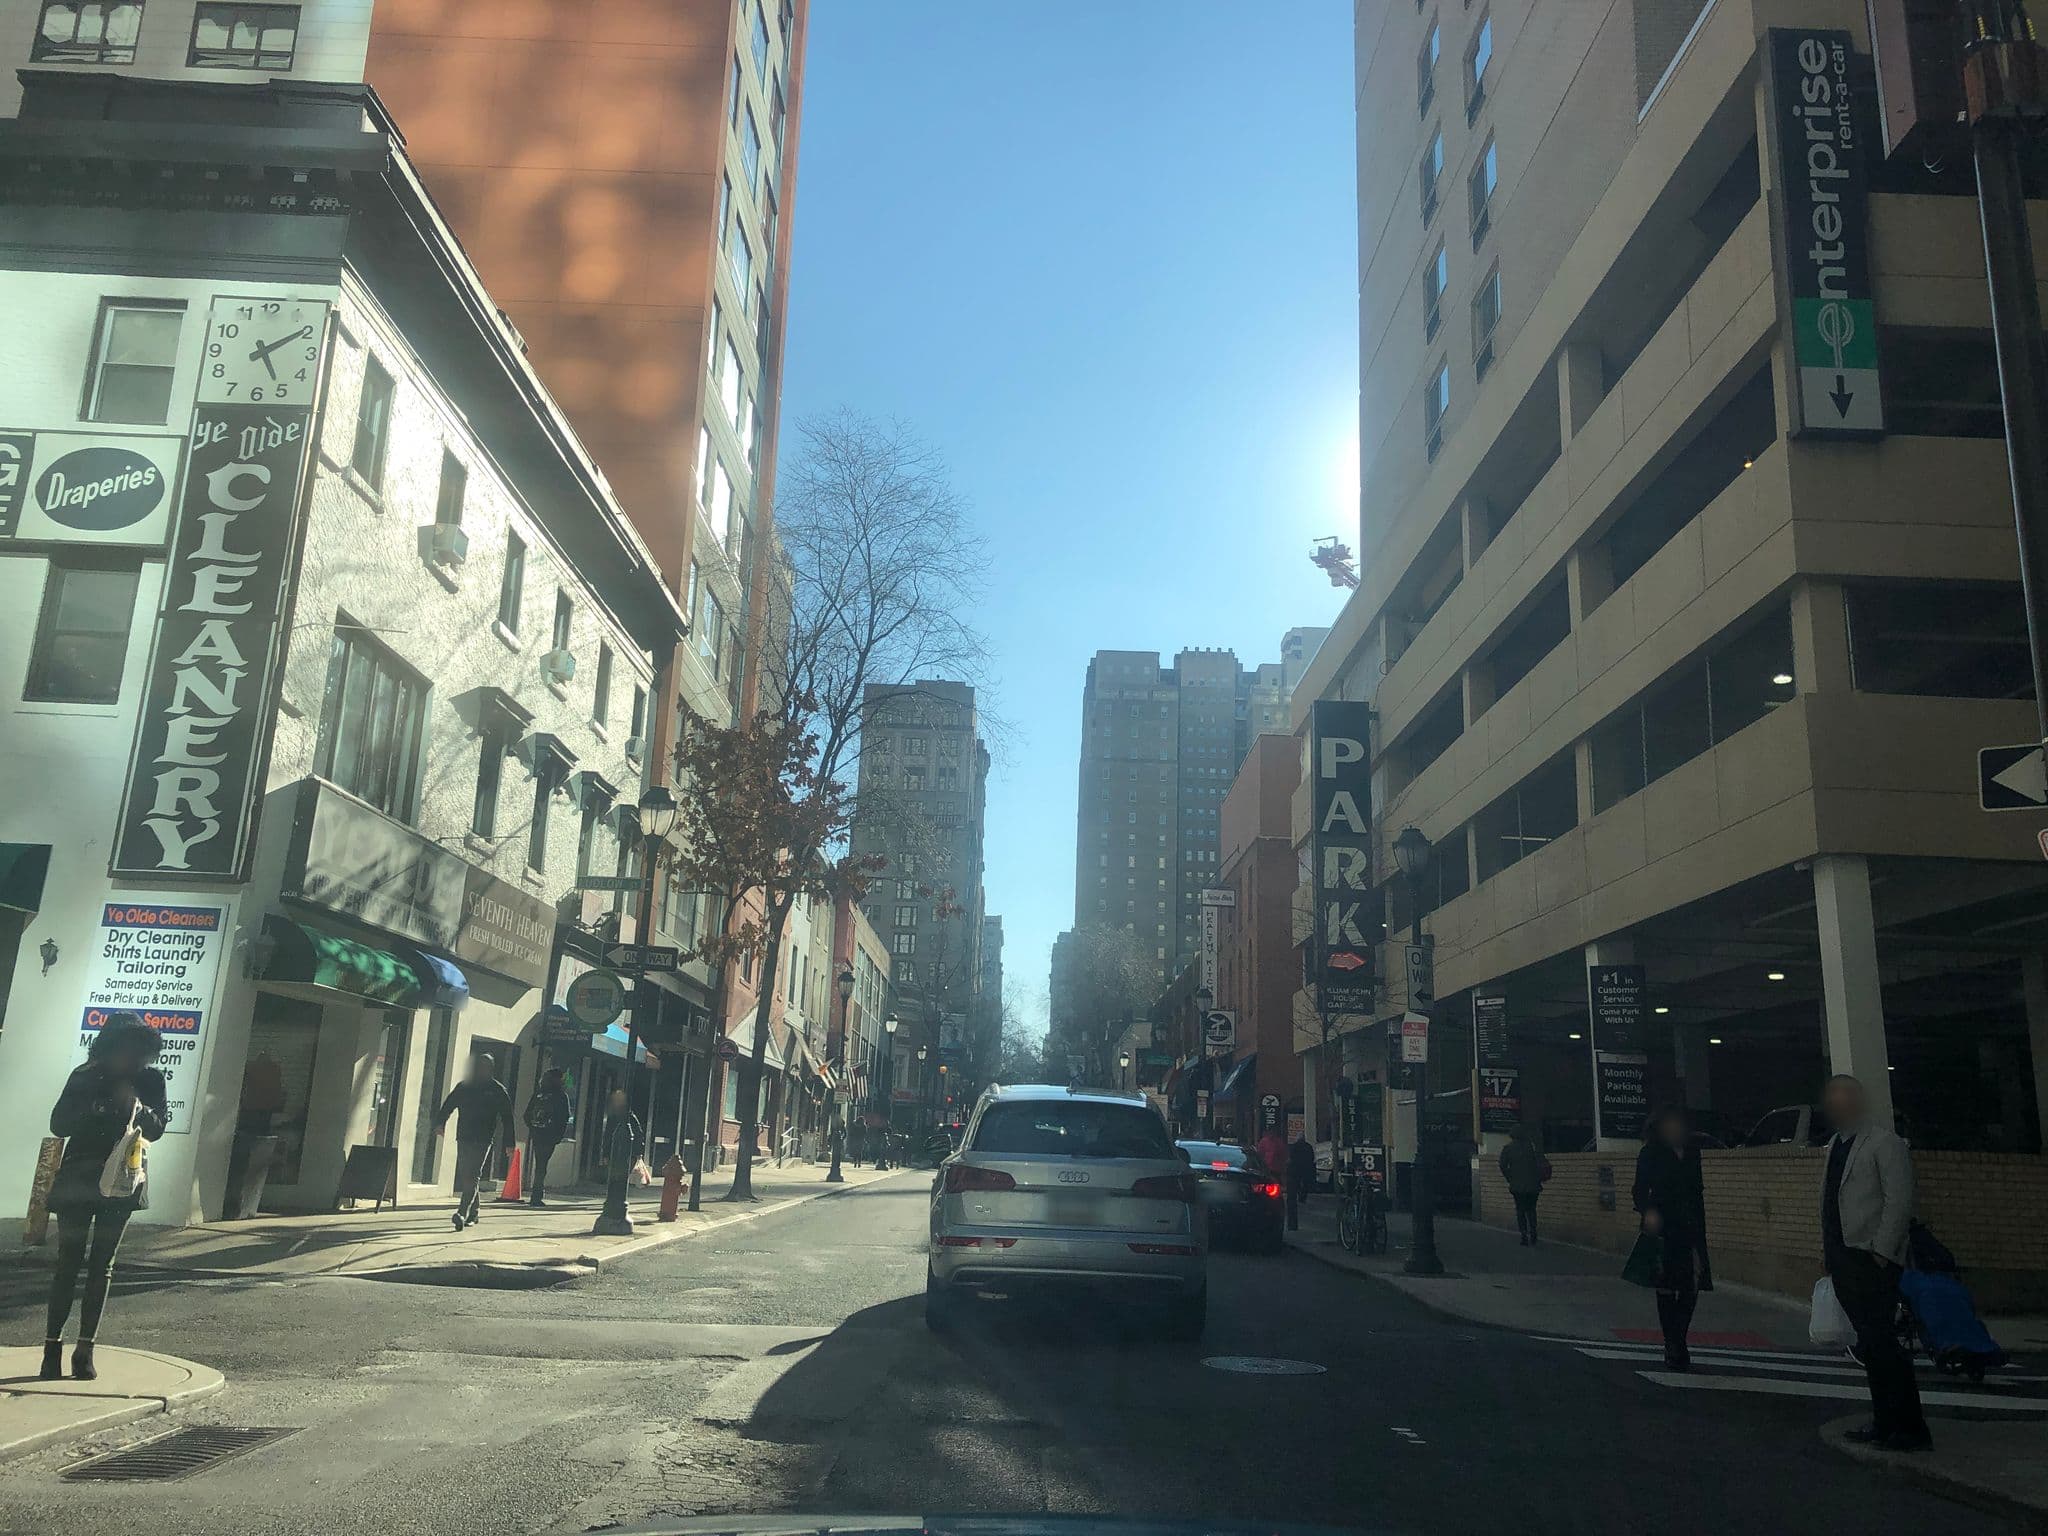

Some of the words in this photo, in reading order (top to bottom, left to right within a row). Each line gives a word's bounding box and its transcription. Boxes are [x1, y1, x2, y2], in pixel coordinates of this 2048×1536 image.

[1831, 40, 1853, 150] rent-a-car
[1792, 37, 1855, 366] enterprise
[217, 323, 240, 339] 10
[302, 325, 314, 340] 2
[208, 343, 222, 358] 9
[304, 346, 317, 361] 3
[211, 363, 225, 379] 8
[294, 367, 307, 382] 4
[226, 382, 239, 396] 7
[250, 387, 264, 401] 6
[275, 383, 288, 398] 5
[45, 464, 156, 511] Draperies
[140, 462, 271, 869] CLEANERY
[1320, 737, 1367, 946] PARK
[107, 906, 124, 923] Ye
[125, 907, 156, 924] Olde
[158, 909, 214, 928] Cleaners
[468, 891, 514, 931] SEVENTH
[516, 914, 552, 947] HEAVEN
[107, 929, 133, 947] Dry
[136, 930, 205, 949] Cleaning
[469, 924, 490, 946] FRESH
[491, 932, 514, 955] ROLLED
[102, 944, 142, 960] Shirts
[144, 946, 205, 965] Laundry
[648, 952, 669, 964] WAY
[116, 960, 187, 978] Tailoring
[104, 978, 154, 993] Sameday
[155, 979, 193, 992] Service
[1597, 986, 1640, 995] Customer
[89, 991, 111, 1004] Free
[113, 992, 134, 1004] Pick
[136, 995, 150, 1006] up
[151, 993, 159, 1005] &
[161, 994, 203, 1008] Delivery
[1603, 995, 1634, 1004] Service
[1599, 1008, 1621, 1016] Come
[1622, 1008, 1640, 1016] Park
[1605, 1017, 1623, 1025] With
[1605, 1068, 1643, 1080] Monthly
[1485, 1077, 1512, 1097] $17
[1607, 1082, 1643, 1093] Parking
[1604, 1095, 1646, 1105] Available
[1360, 1154, 1375, 1171] $8
